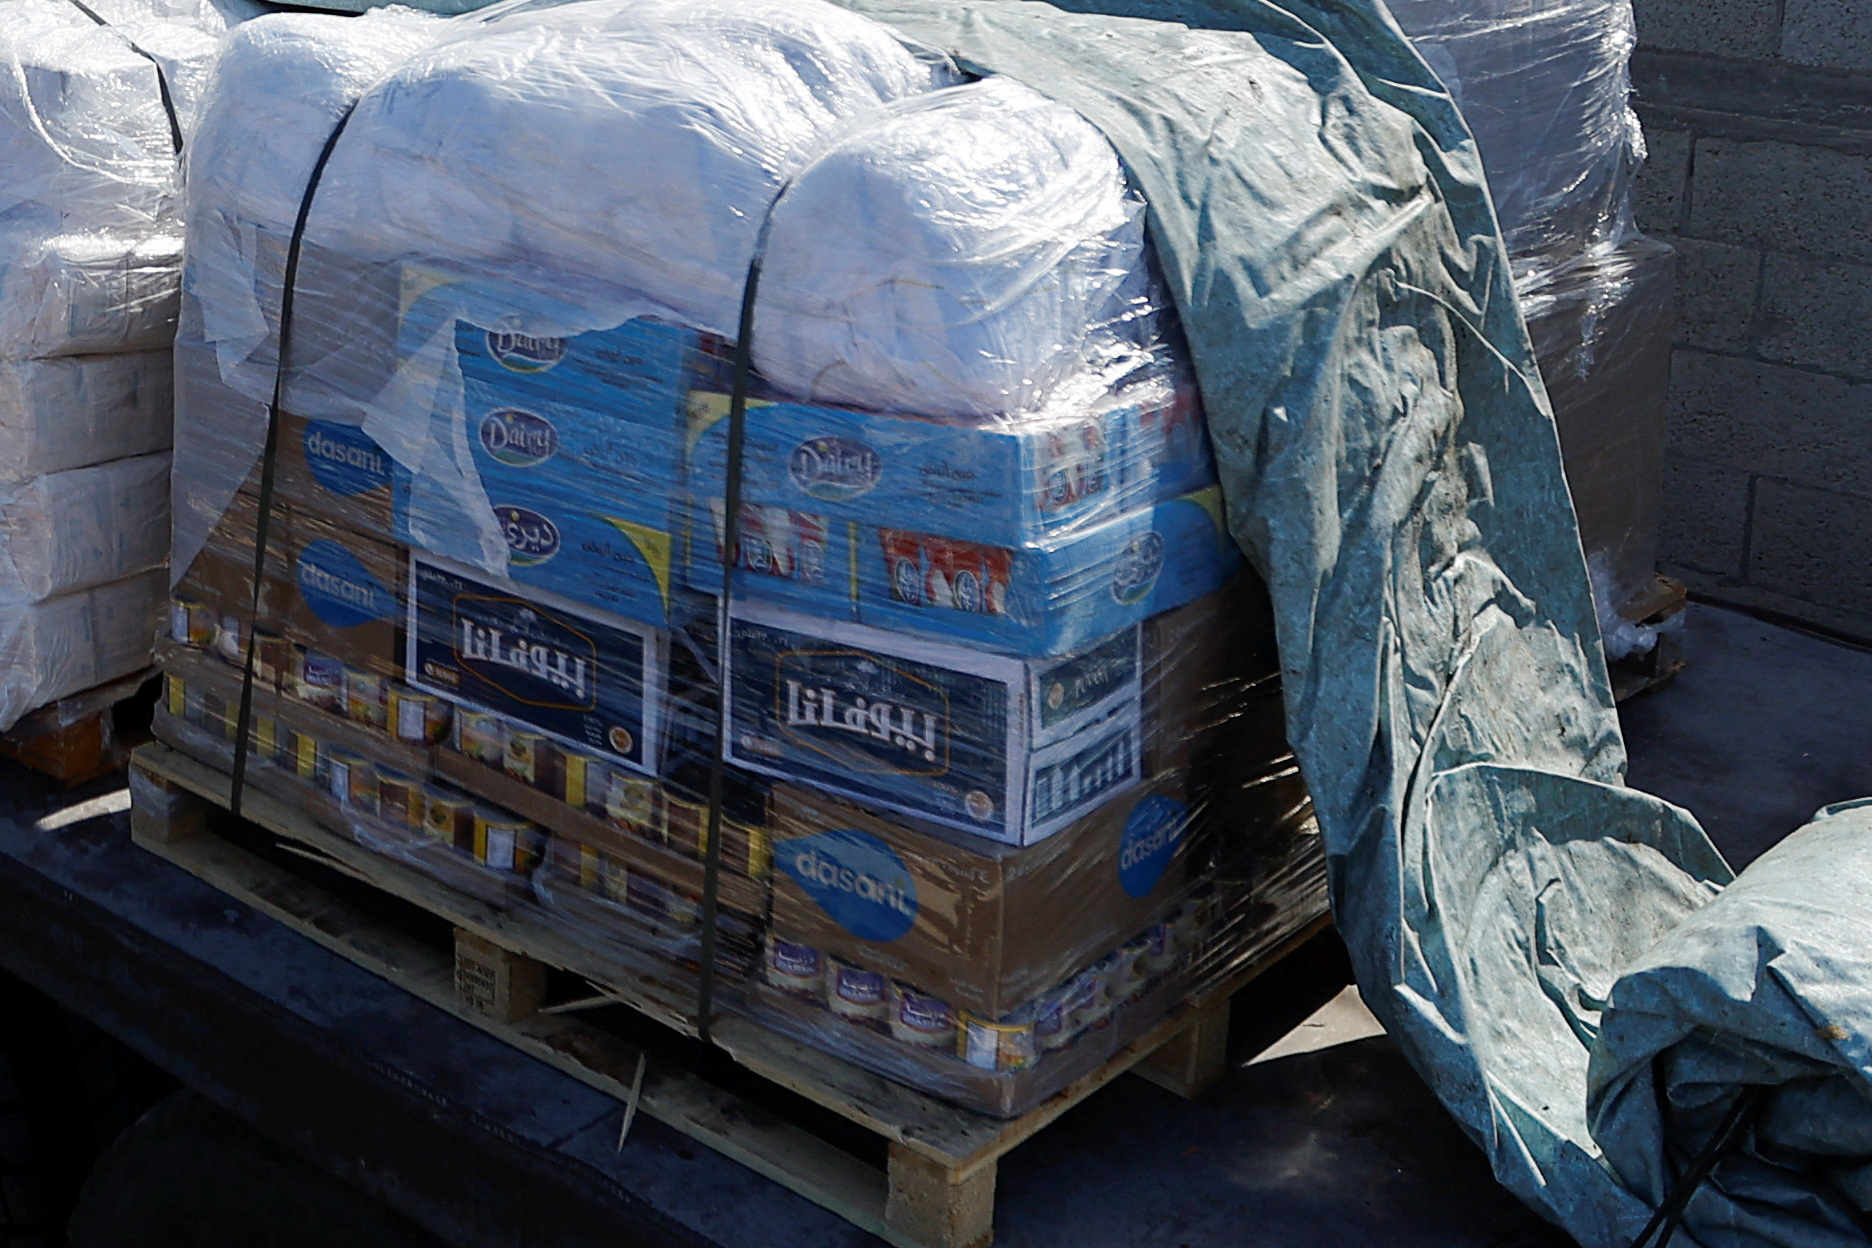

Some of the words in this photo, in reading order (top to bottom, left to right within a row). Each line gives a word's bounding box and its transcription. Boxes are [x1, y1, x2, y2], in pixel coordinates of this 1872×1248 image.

[307, 431, 384, 475] dasani
[491, 417, 550, 456] Dairy
[798, 445, 874, 481] Dairy
[300, 563, 376, 609] dasani
[795, 850, 908, 915] dasani
